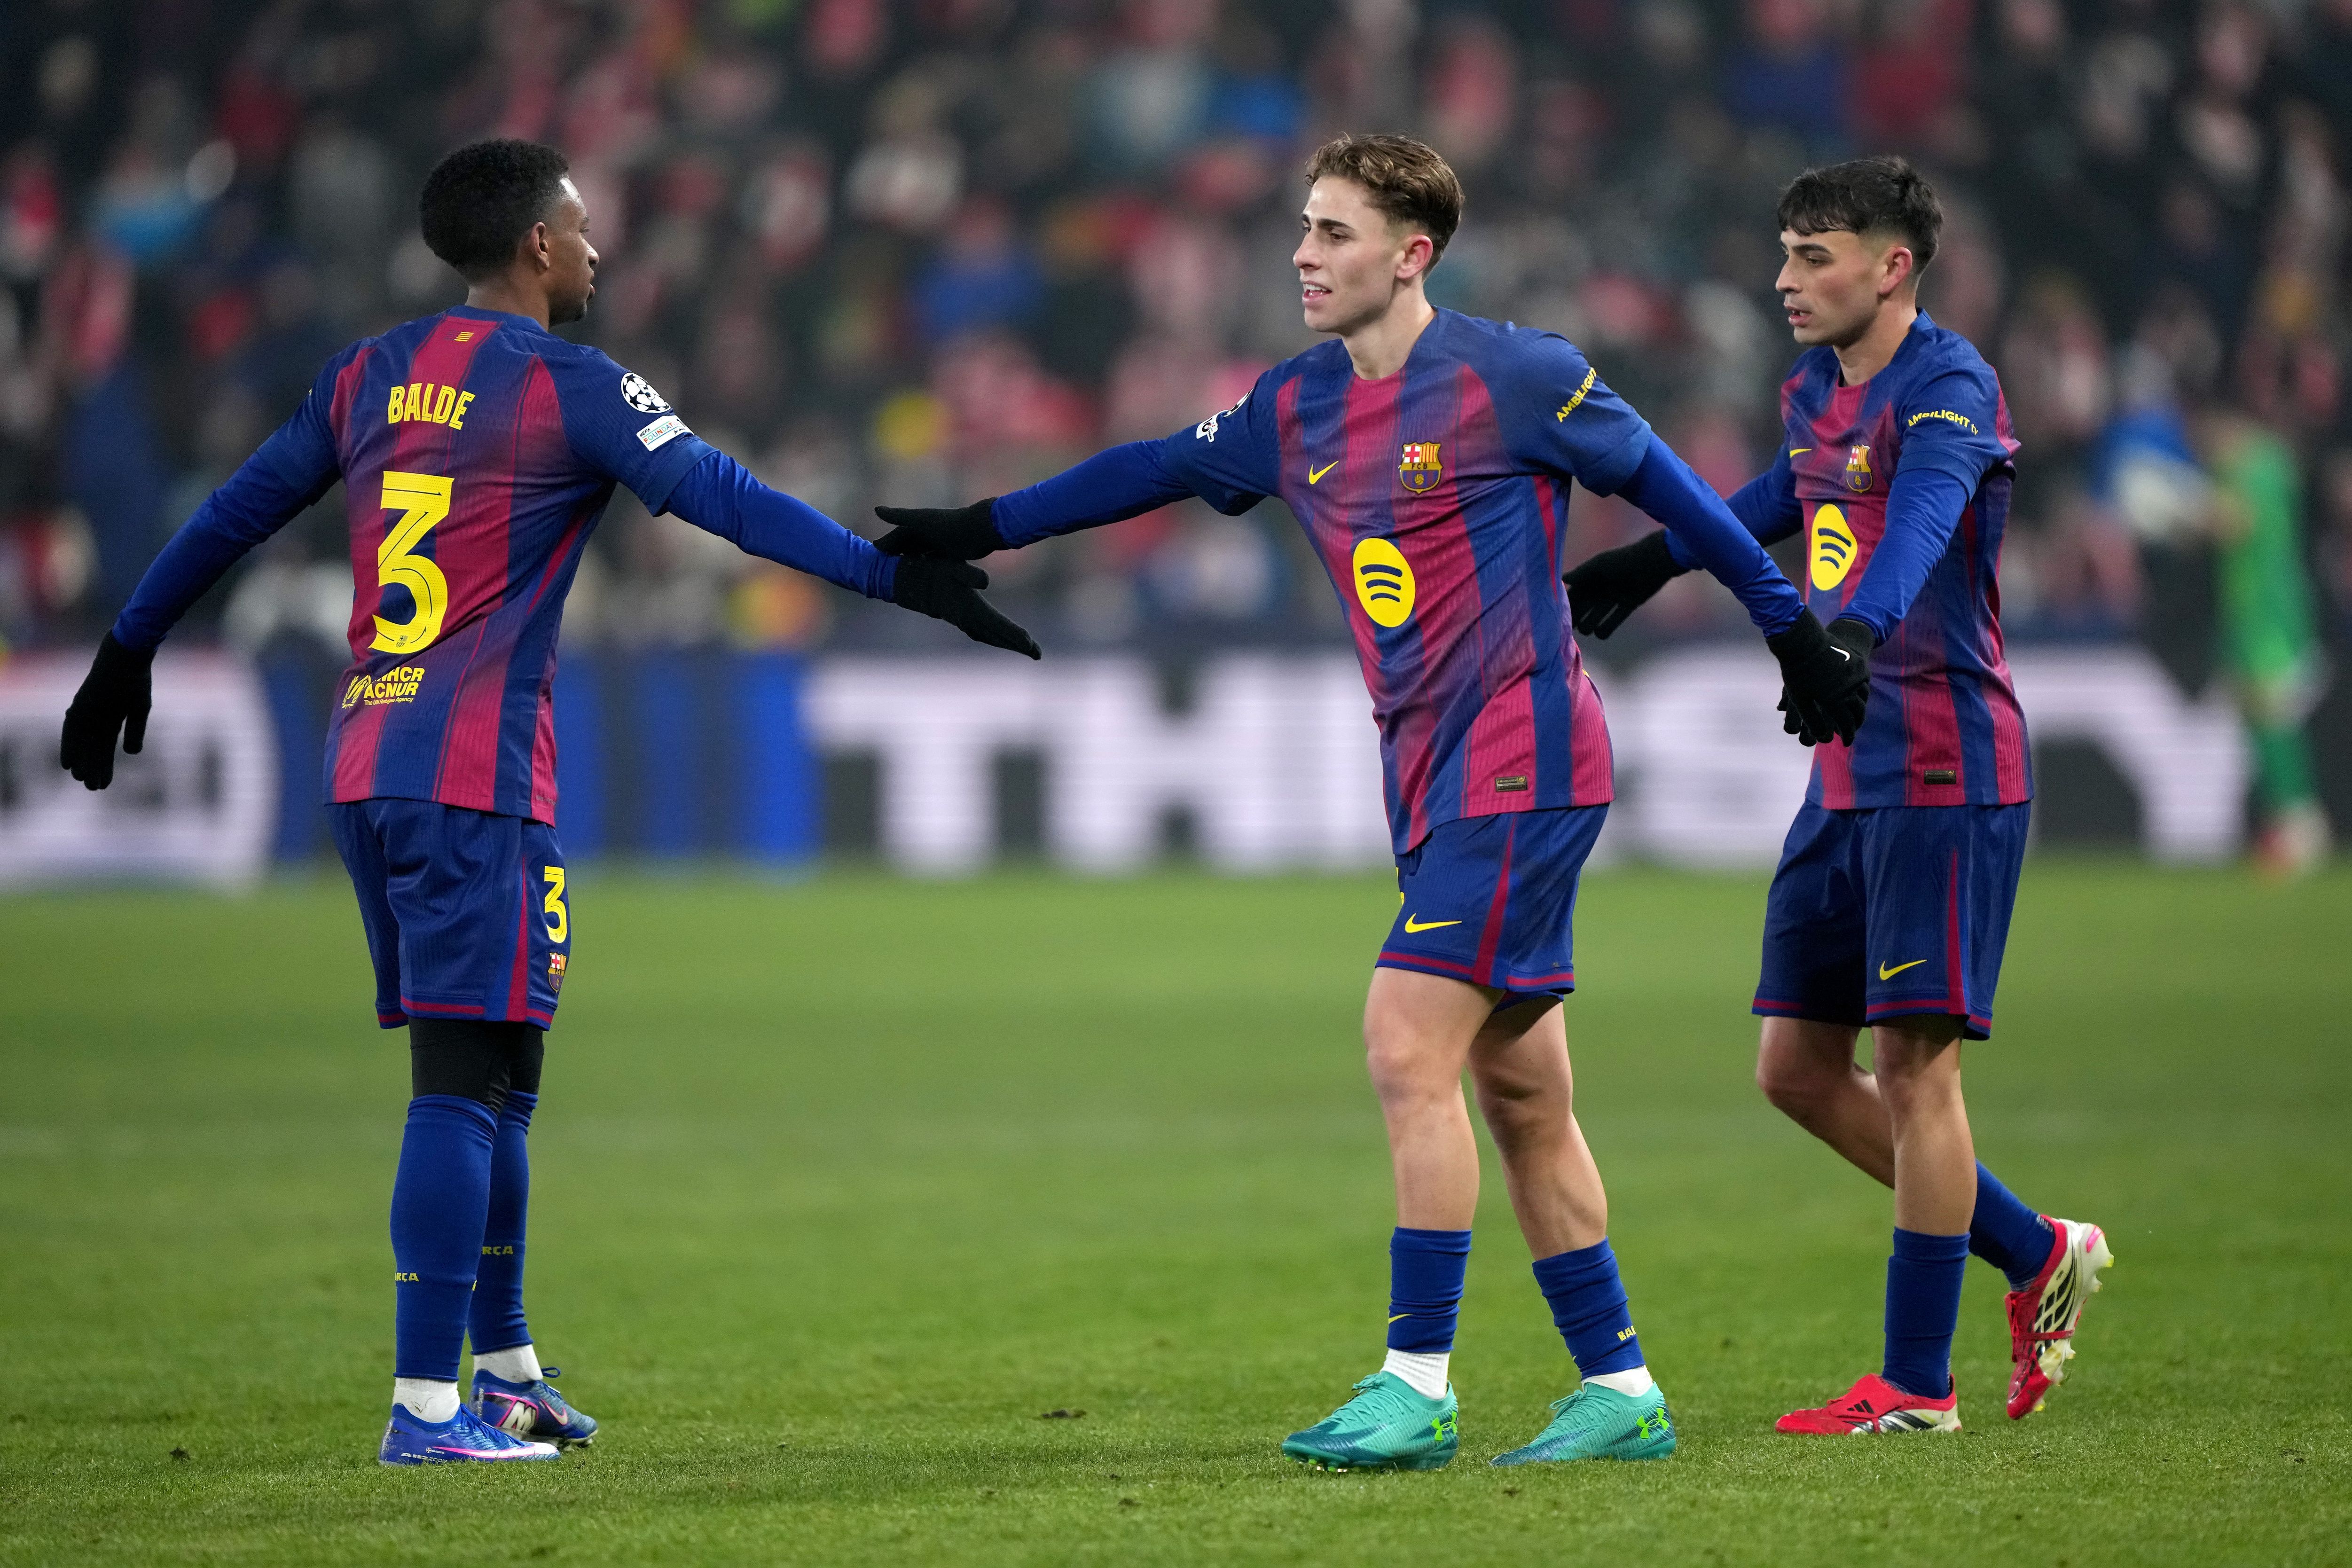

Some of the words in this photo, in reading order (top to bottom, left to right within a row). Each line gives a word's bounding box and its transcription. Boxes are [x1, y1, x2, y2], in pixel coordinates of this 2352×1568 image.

[388, 383, 476, 430] BALDE
[1557, 368, 1597, 423] AMBILIGHT
[1908, 409, 1970, 427] AMBILIGHT
[639, 428, 651, 437] UEFA
[643, 422, 681, 444] FOUNDAT
[367, 470, 455, 654] 3
[363, 682, 419, 699] ACNUR
[544, 866, 568, 943] 3
[395, 1272, 420, 1282] RÇA
